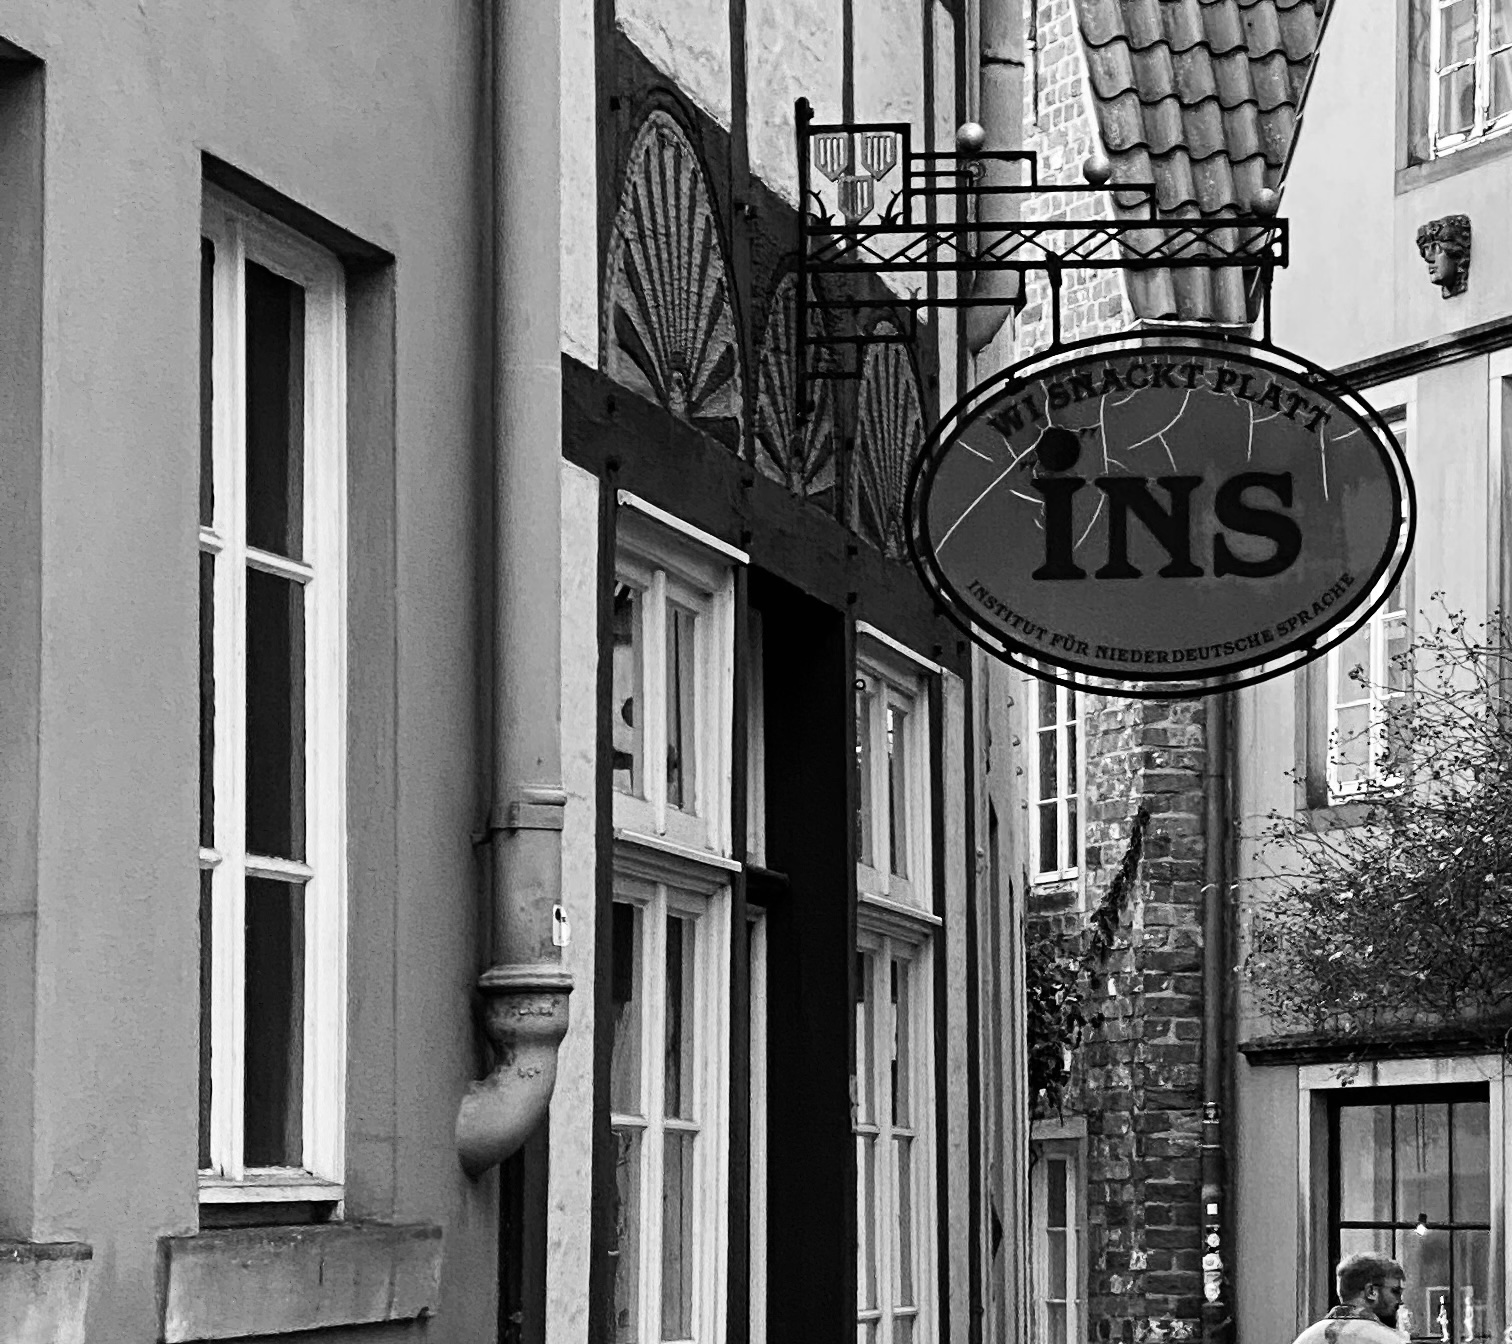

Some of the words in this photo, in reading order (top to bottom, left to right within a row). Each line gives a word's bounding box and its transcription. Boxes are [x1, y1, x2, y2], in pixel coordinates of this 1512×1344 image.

[987, 394, 1045, 437] WI
[1047, 362, 1205, 410] SNACKT
[1211, 365, 1332, 433] PLATT
[968, 579, 1048, 641] INSTITUT
[1051, 632, 1089, 657] FÜR
[1095, 629, 1275, 664] NIEDERDEUTSCHE
[1275, 572, 1355, 637] SPRACHE
